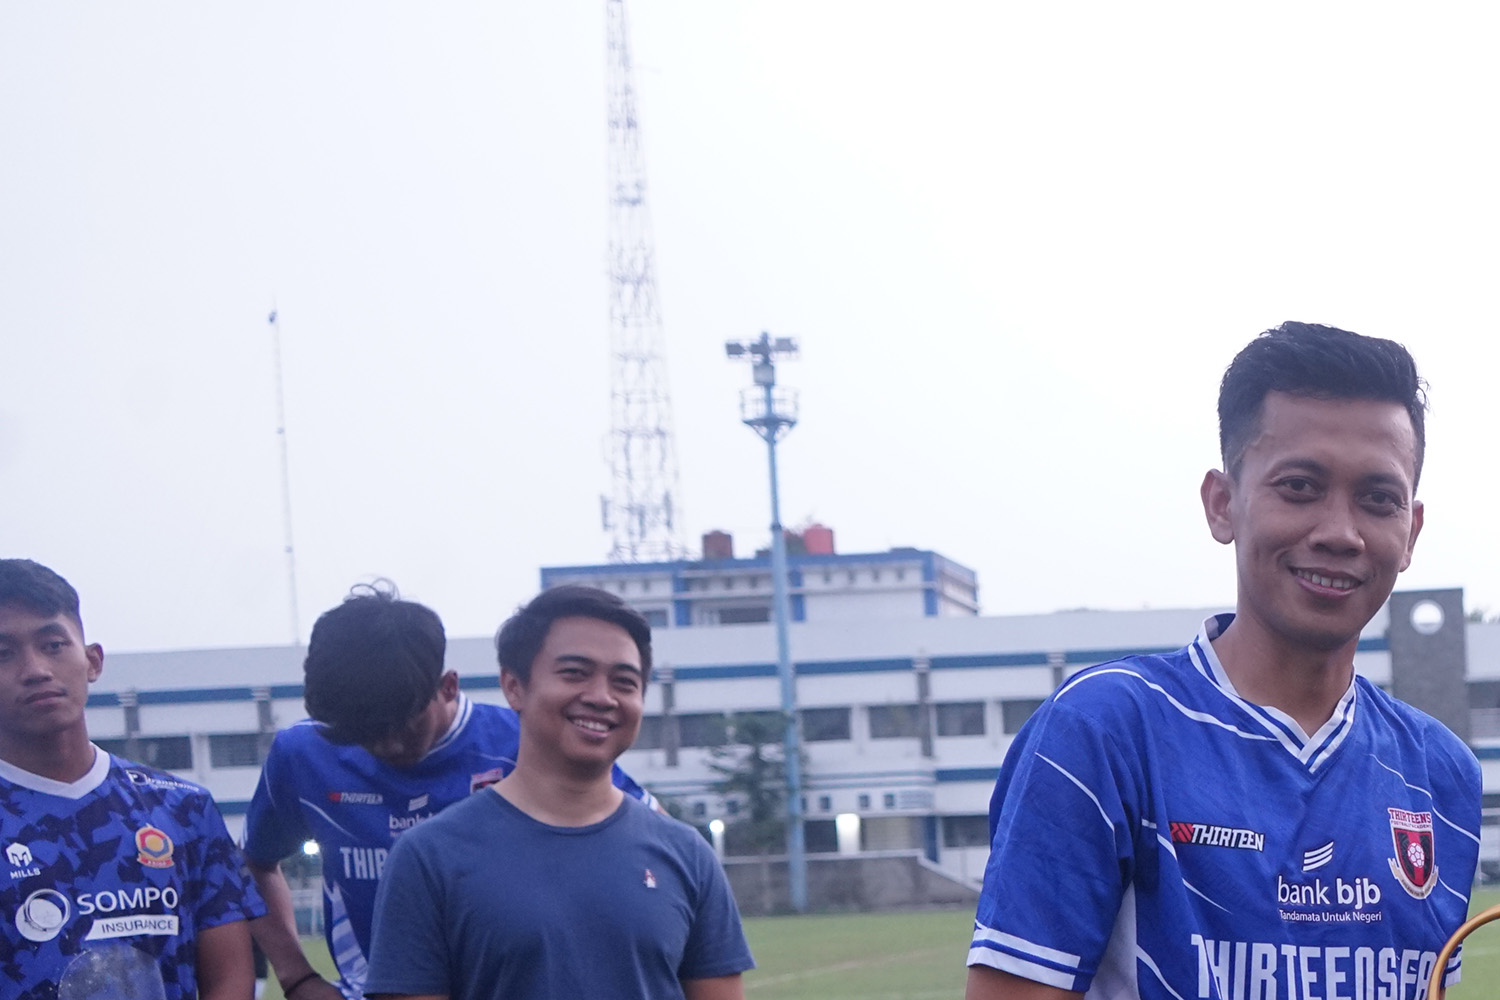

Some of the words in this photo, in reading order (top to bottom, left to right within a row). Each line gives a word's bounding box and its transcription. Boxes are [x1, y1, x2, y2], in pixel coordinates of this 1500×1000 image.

[1389, 809, 1431, 824] THIRTEENS
[1190, 823, 1265, 852] THIRTEEN
[10, 867, 41, 880] MILLS
[1276, 875, 1331, 905] bank
[1336, 877, 1381, 910] bjb
[76, 887, 178, 915] SOMPO
[1279, 909, 1320, 922] Tandamata
[1322, 911, 1351, 922] Untuk
[1352, 911, 1382, 924] Negeri
[101, 919, 174, 934] INSURANCE
